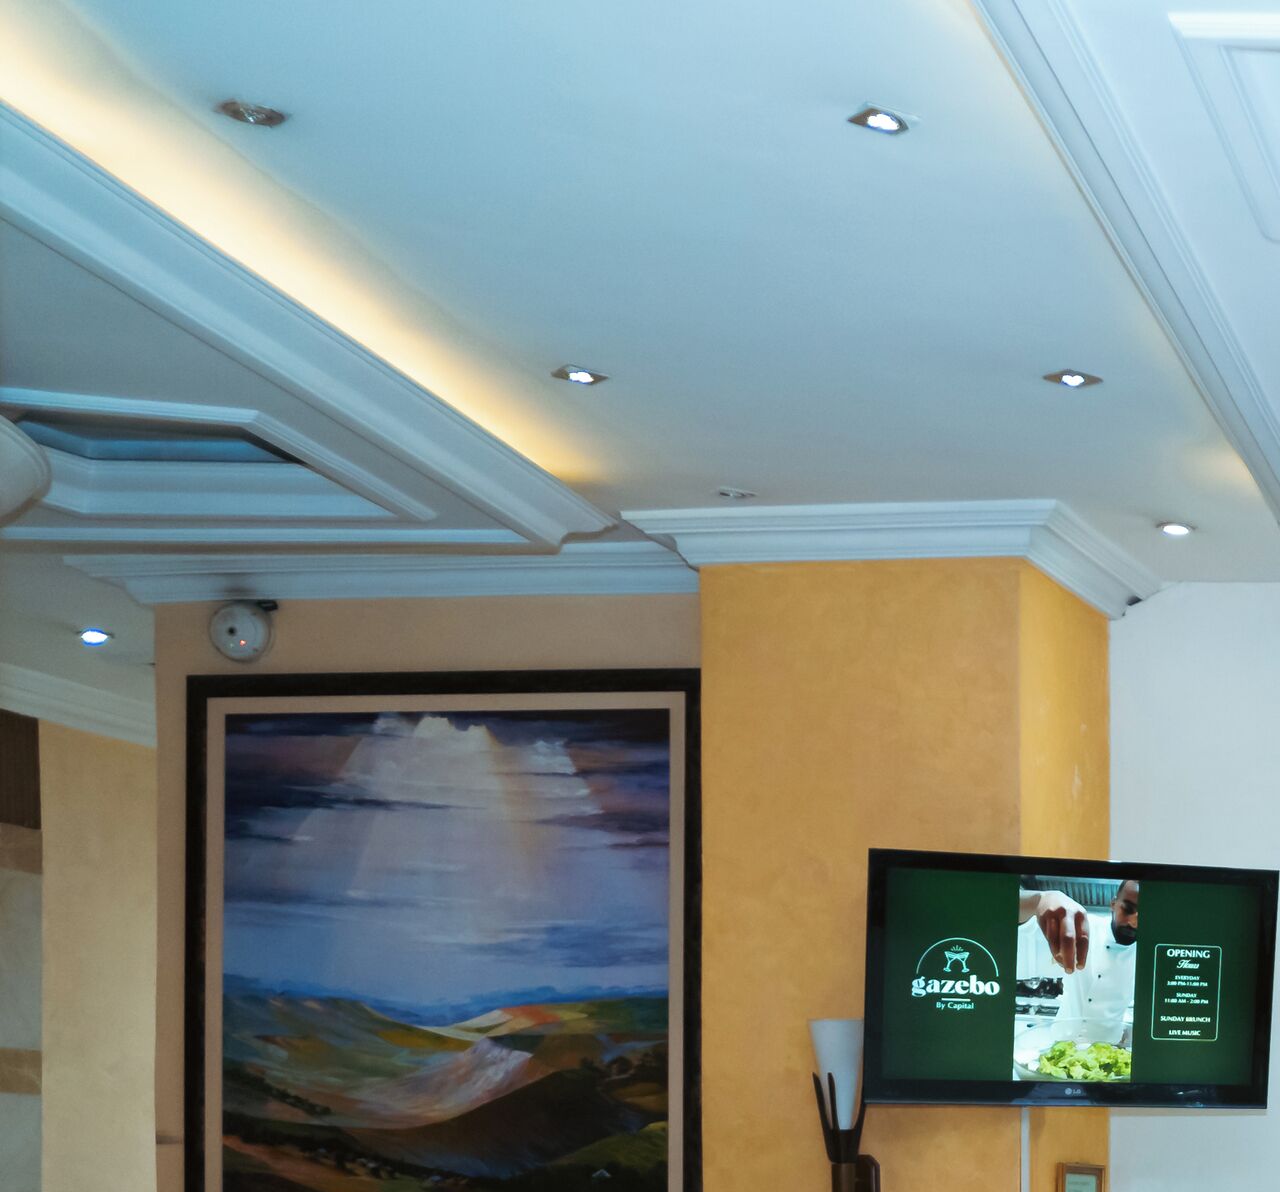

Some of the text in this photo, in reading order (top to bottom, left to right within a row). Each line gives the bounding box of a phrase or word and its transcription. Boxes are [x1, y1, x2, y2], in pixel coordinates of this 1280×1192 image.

[1167, 949, 1210, 958] OPENING
[911, 975, 1000, 997] gazebo
[936, 1002, 974, 1010] By Capital
